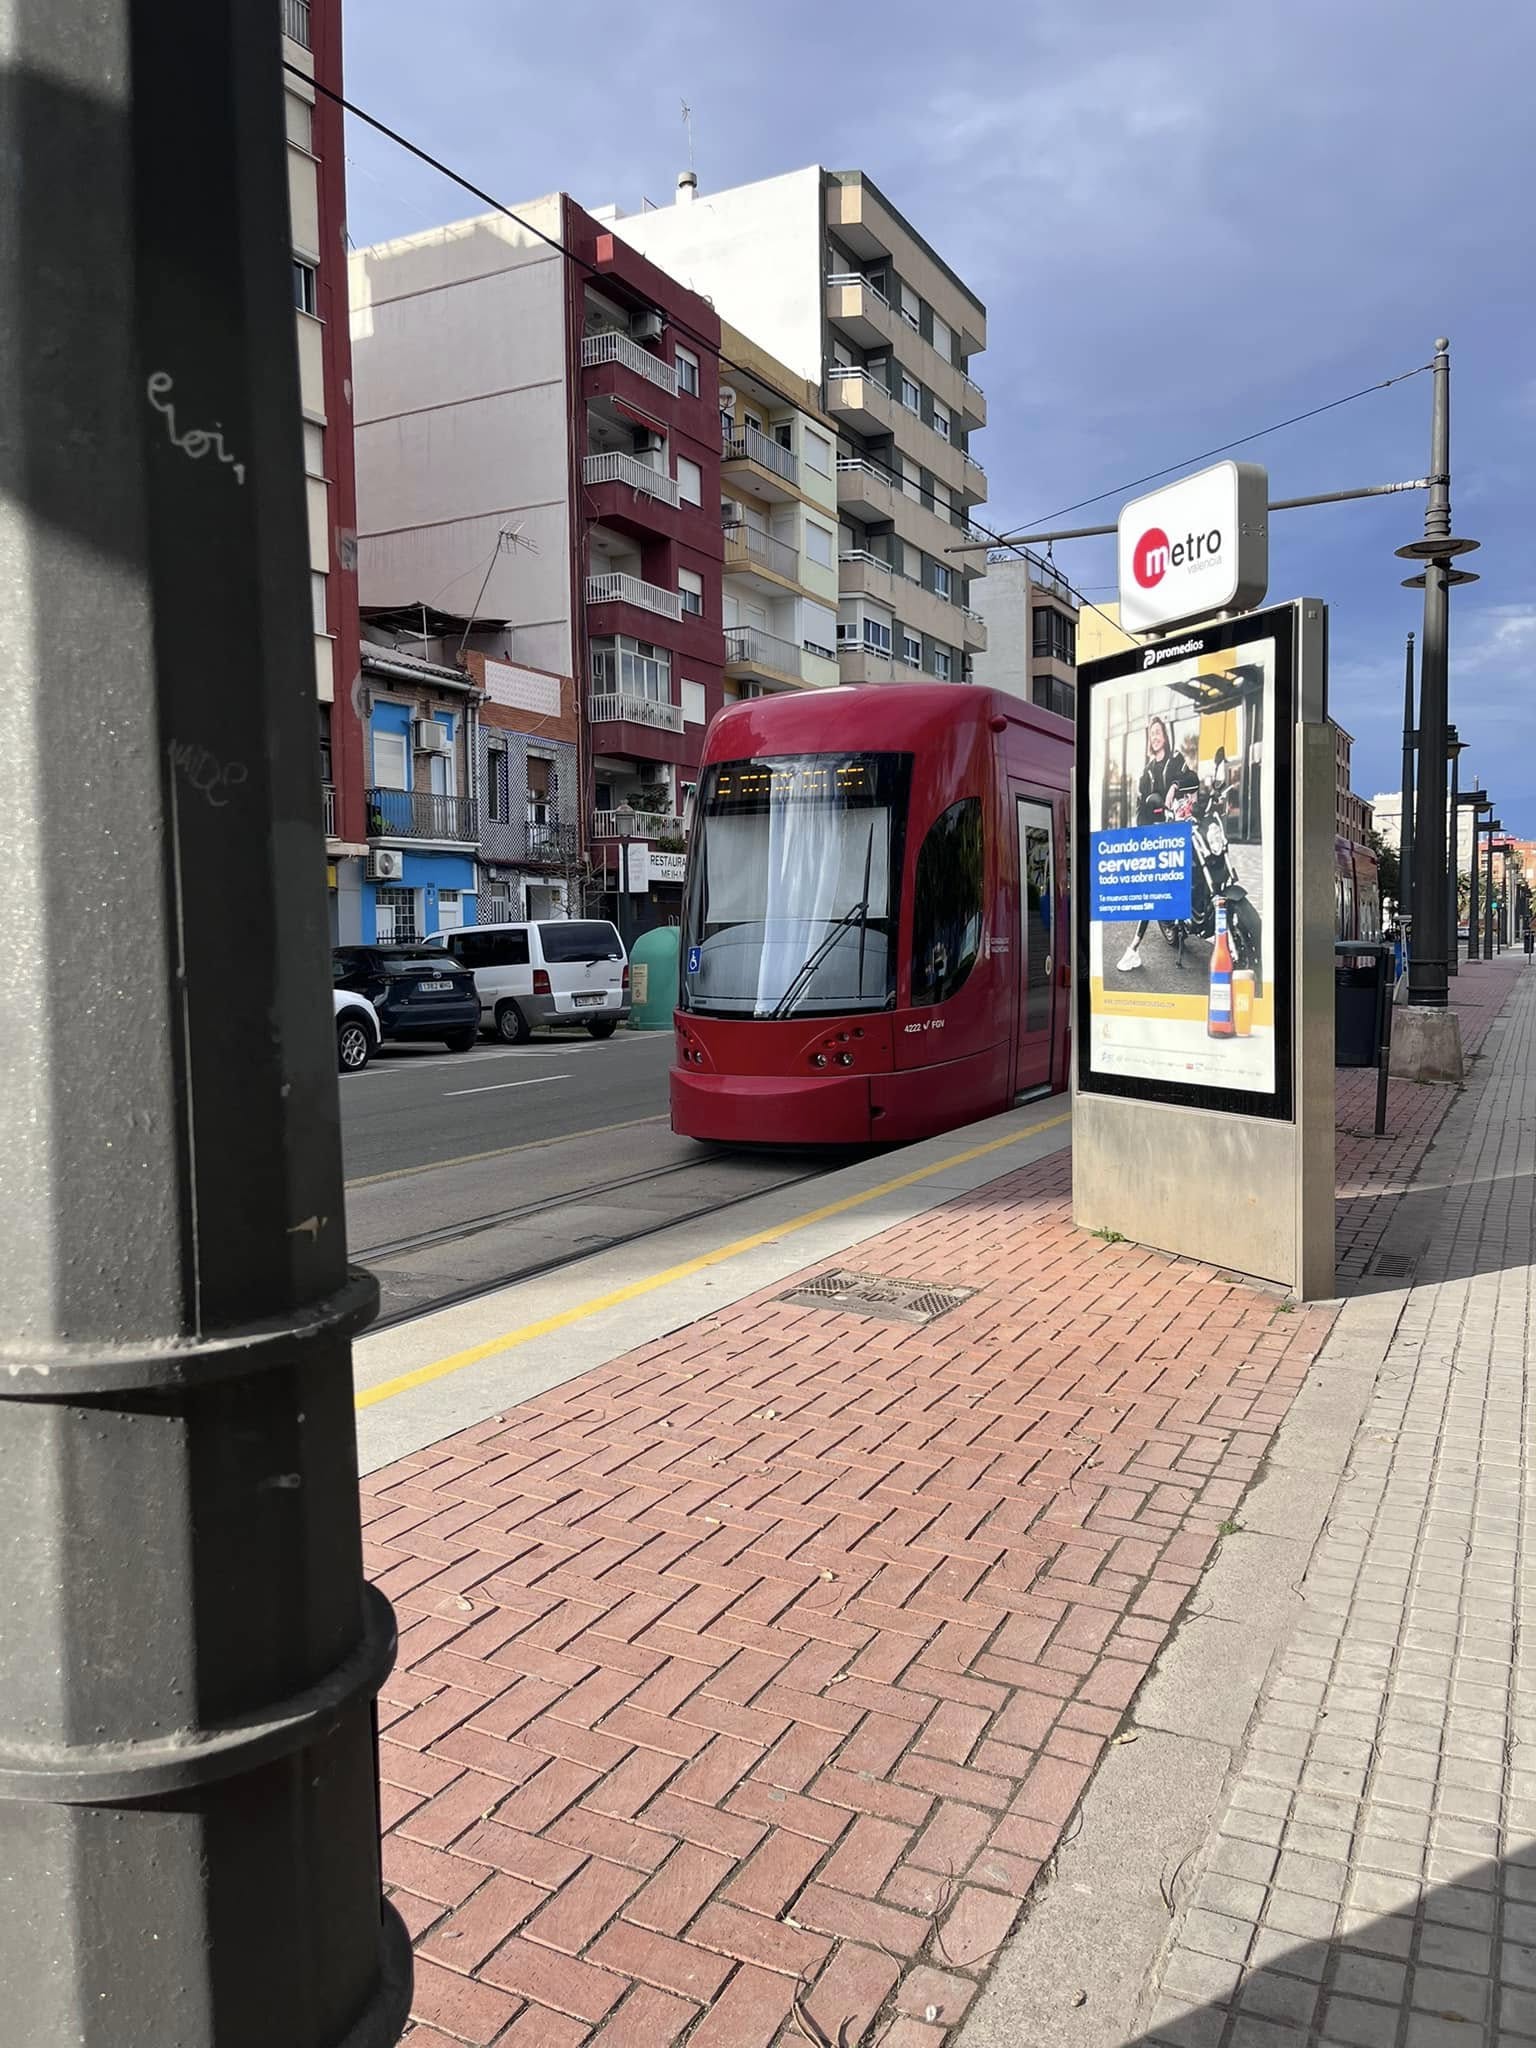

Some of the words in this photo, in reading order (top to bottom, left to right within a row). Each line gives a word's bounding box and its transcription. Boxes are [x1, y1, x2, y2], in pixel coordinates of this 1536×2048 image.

[1146, 529, 1222, 577] metro
[1156, 639, 1204, 663] promedios
[1098, 838, 1138, 855] Cuando
[1140, 836, 1185, 852] decimos
[1098, 857, 1156, 873] cerveza
[1158, 851, 1184, 869] SIN
[1098, 873, 1119, 885] todo
[1120, 875, 1131, 884] va
[1131, 871, 1154, 883] sobre
[1155, 869, 1185, 882] ruedas
[1099, 904, 1121, 913] siempre
[1143, 902, 1154, 910] SIN
[904, 1023, 921, 1033] 4222
[931, 1019, 945, 1029] FGV
